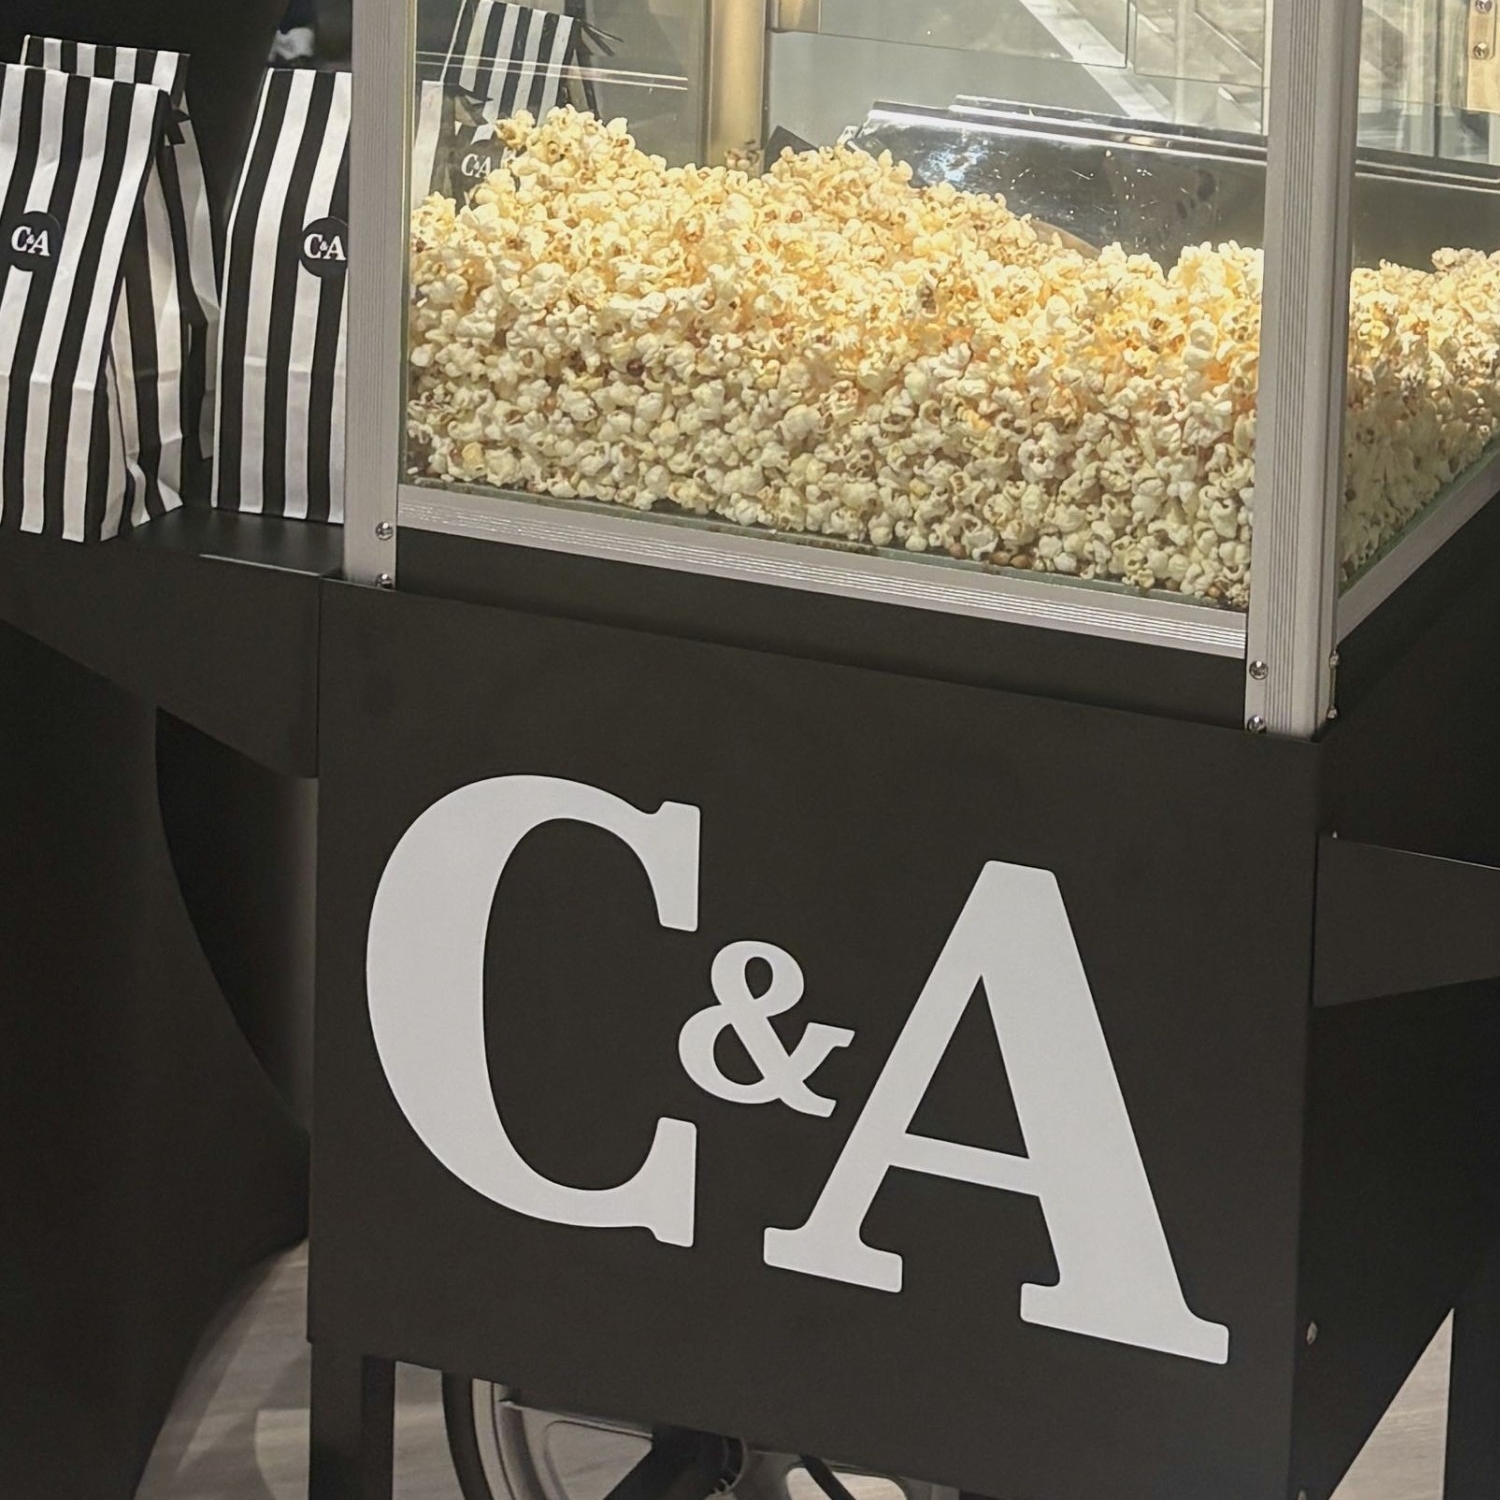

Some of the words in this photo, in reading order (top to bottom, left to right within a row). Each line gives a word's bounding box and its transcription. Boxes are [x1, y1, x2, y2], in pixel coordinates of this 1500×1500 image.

[11, 225, 51, 257] C&A
[303, 233, 347, 261] C&A
[366, 775, 1229, 1365] C&A
